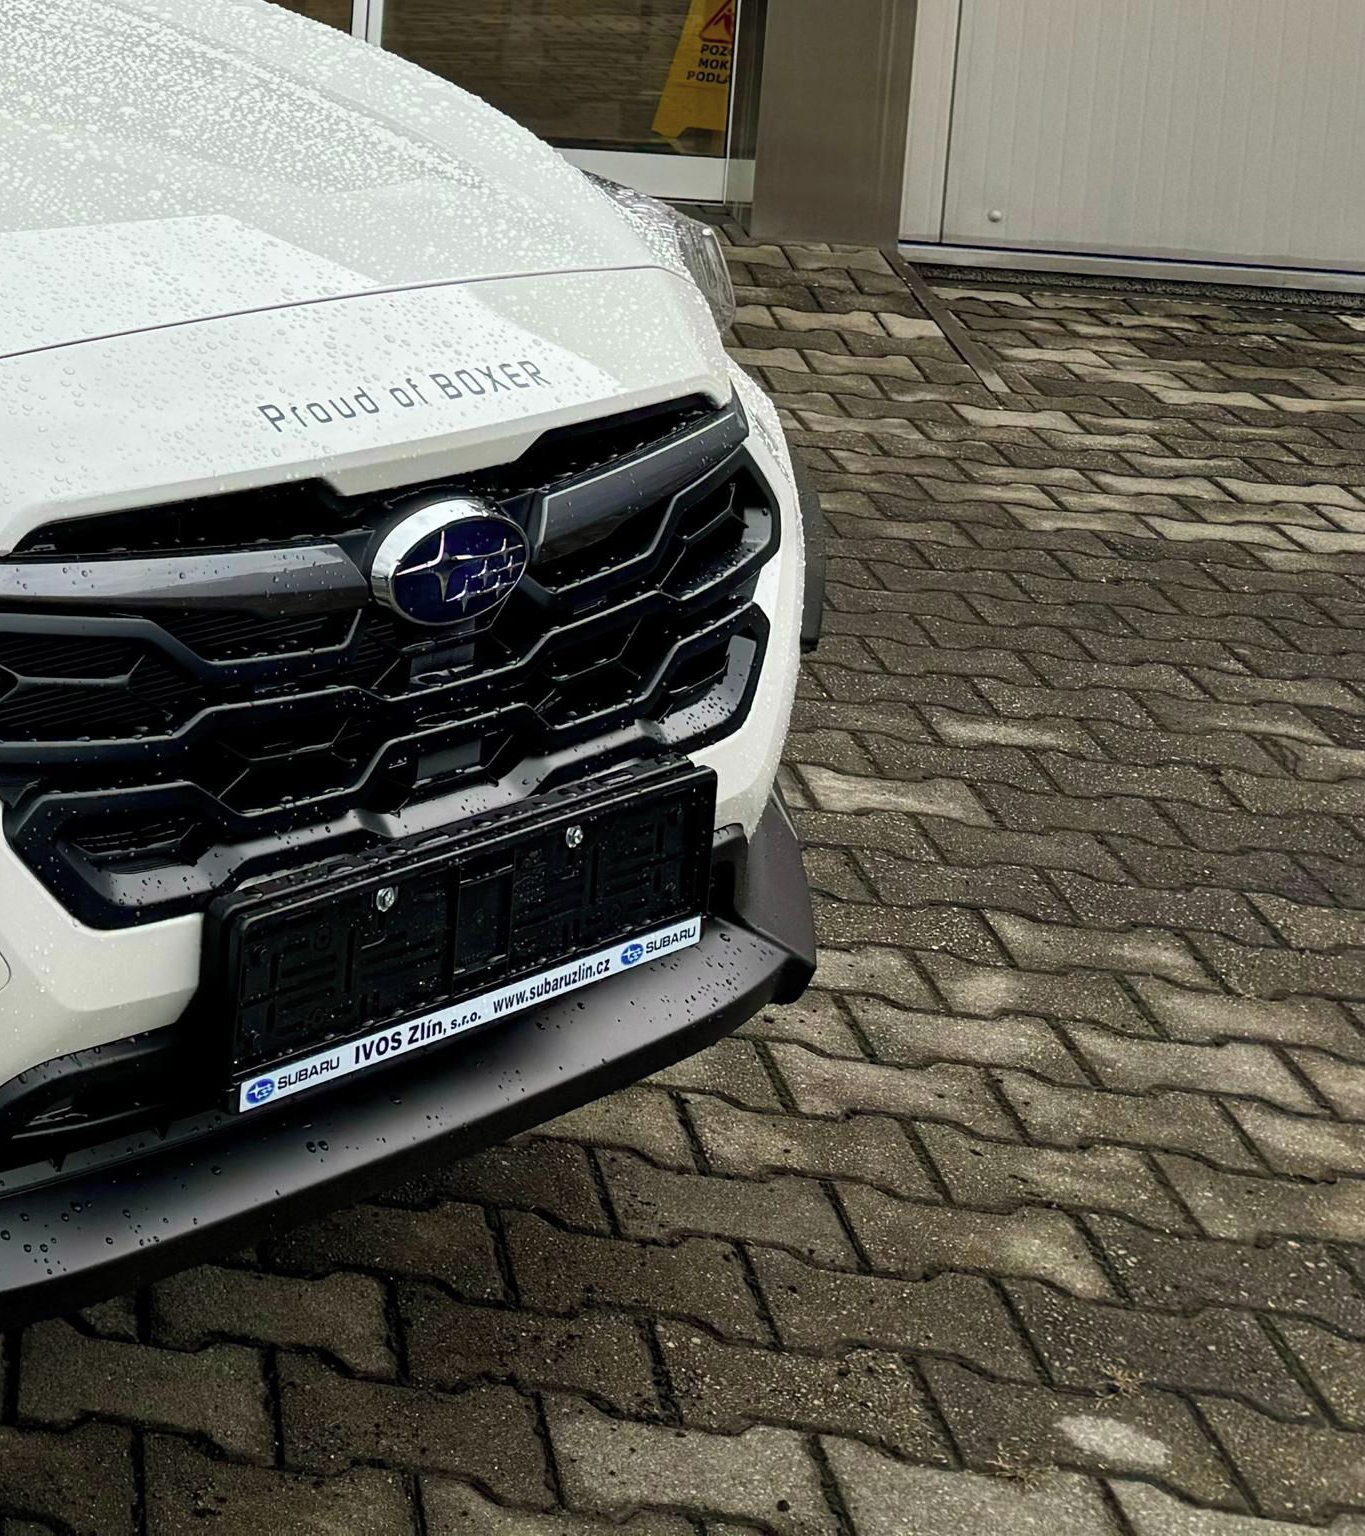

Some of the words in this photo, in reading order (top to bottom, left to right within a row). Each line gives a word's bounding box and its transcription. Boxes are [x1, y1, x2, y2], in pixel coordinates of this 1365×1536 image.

[701, 44, 733, 56] POZ
[257, 386, 380, 433] Proud
[389, 377, 429, 408] of
[429, 360, 552, 399] BOXER
[277, 1057, 340, 1090] SUBARU
[354, 1031, 402, 1064] IVOS
[407, 1019, 447, 1046] Zlín,
[450, 1012, 481, 1030] s.r.o.
[492, 957, 610, 1014] www.subaruzlin.cz
[645, 926, 696, 953] SUBARU
